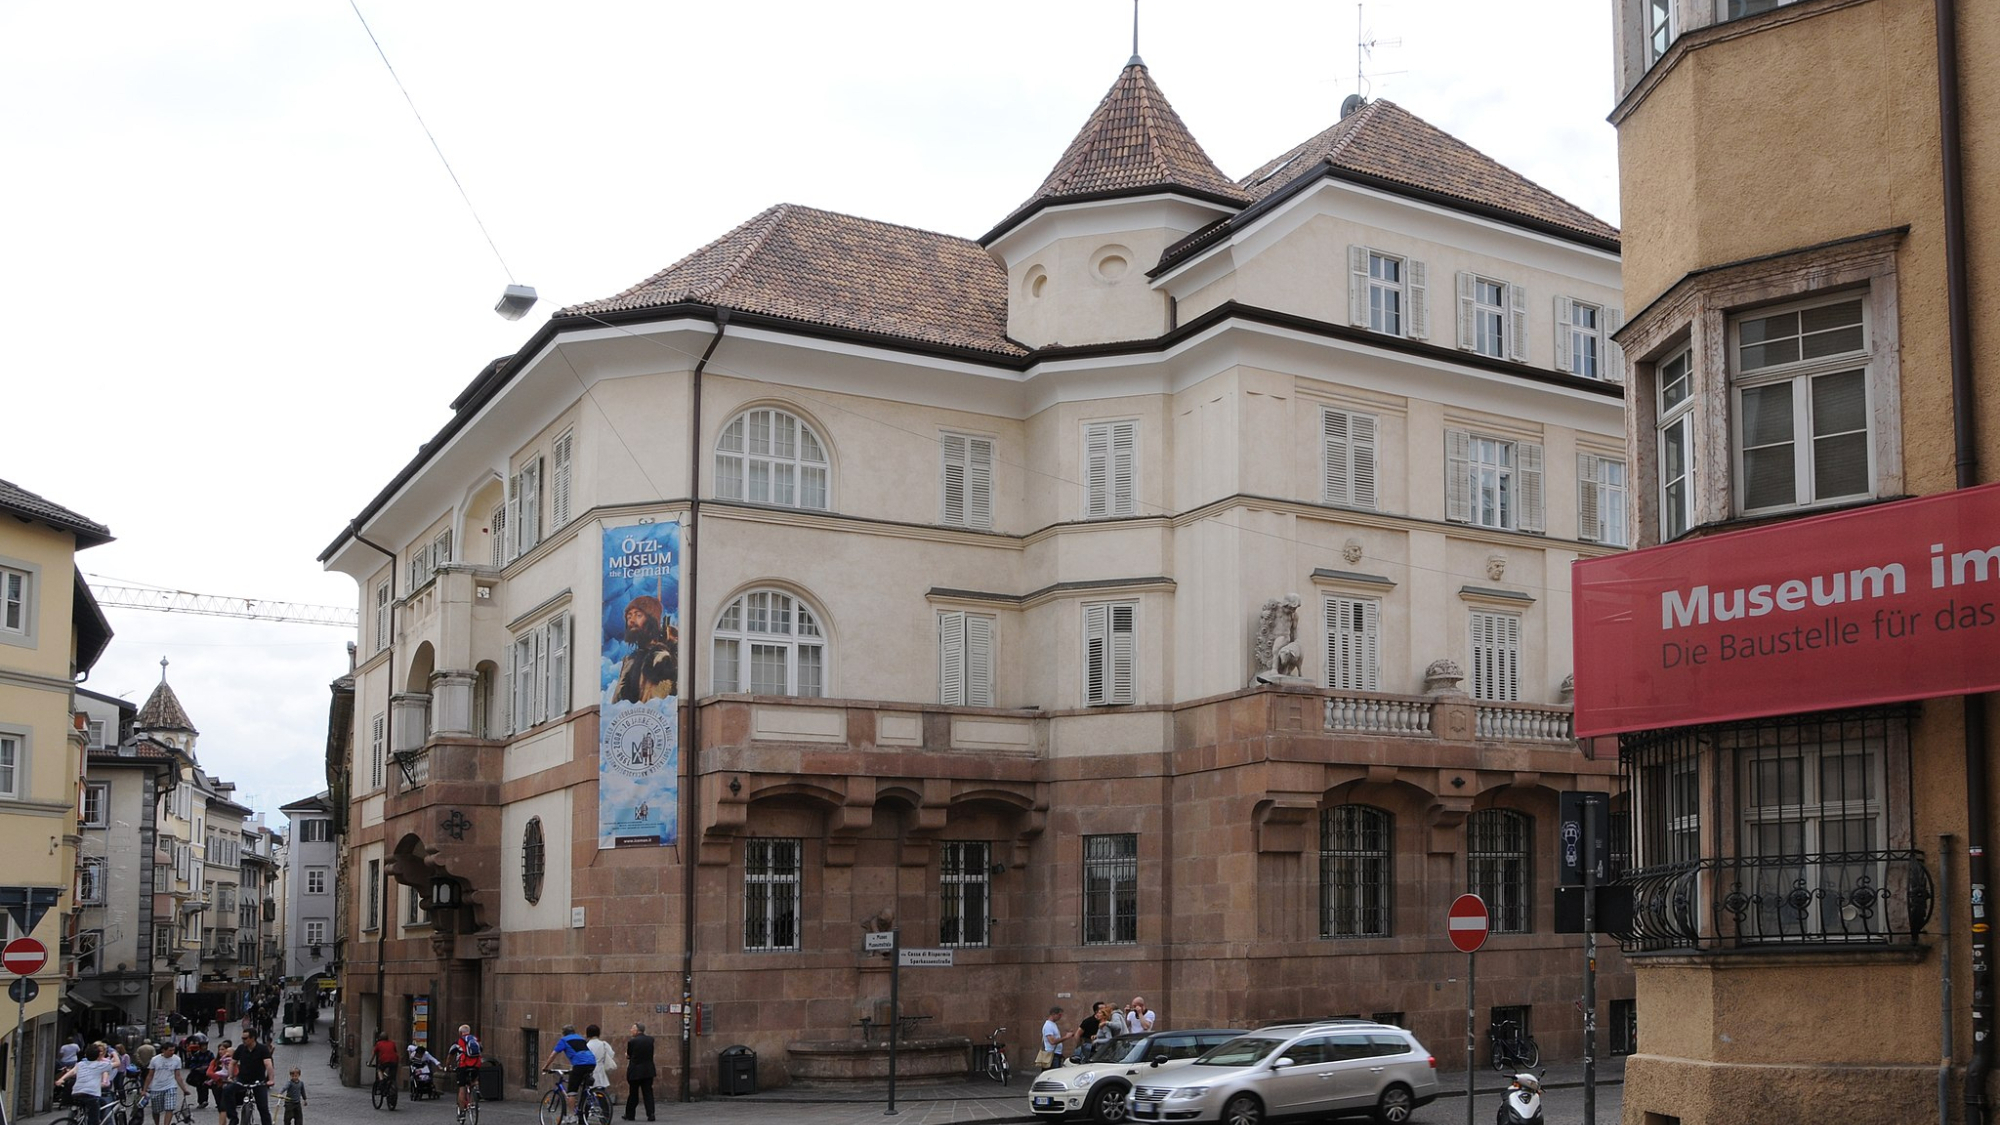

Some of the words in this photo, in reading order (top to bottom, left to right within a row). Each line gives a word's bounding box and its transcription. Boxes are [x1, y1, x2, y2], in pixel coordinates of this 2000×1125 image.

[609, 552, 671, 569] MUSEUM
[623, 565, 670, 579] Iceman
[1661, 562, 1906, 630] Museum
[1930, 543, 2000, 589] im
[1663, 639, 1708, 669] Die
[1720, 616, 1860, 661] Baustelle
[1872, 609, 1922, 640] für
[1934, 599, 1996, 632] das
